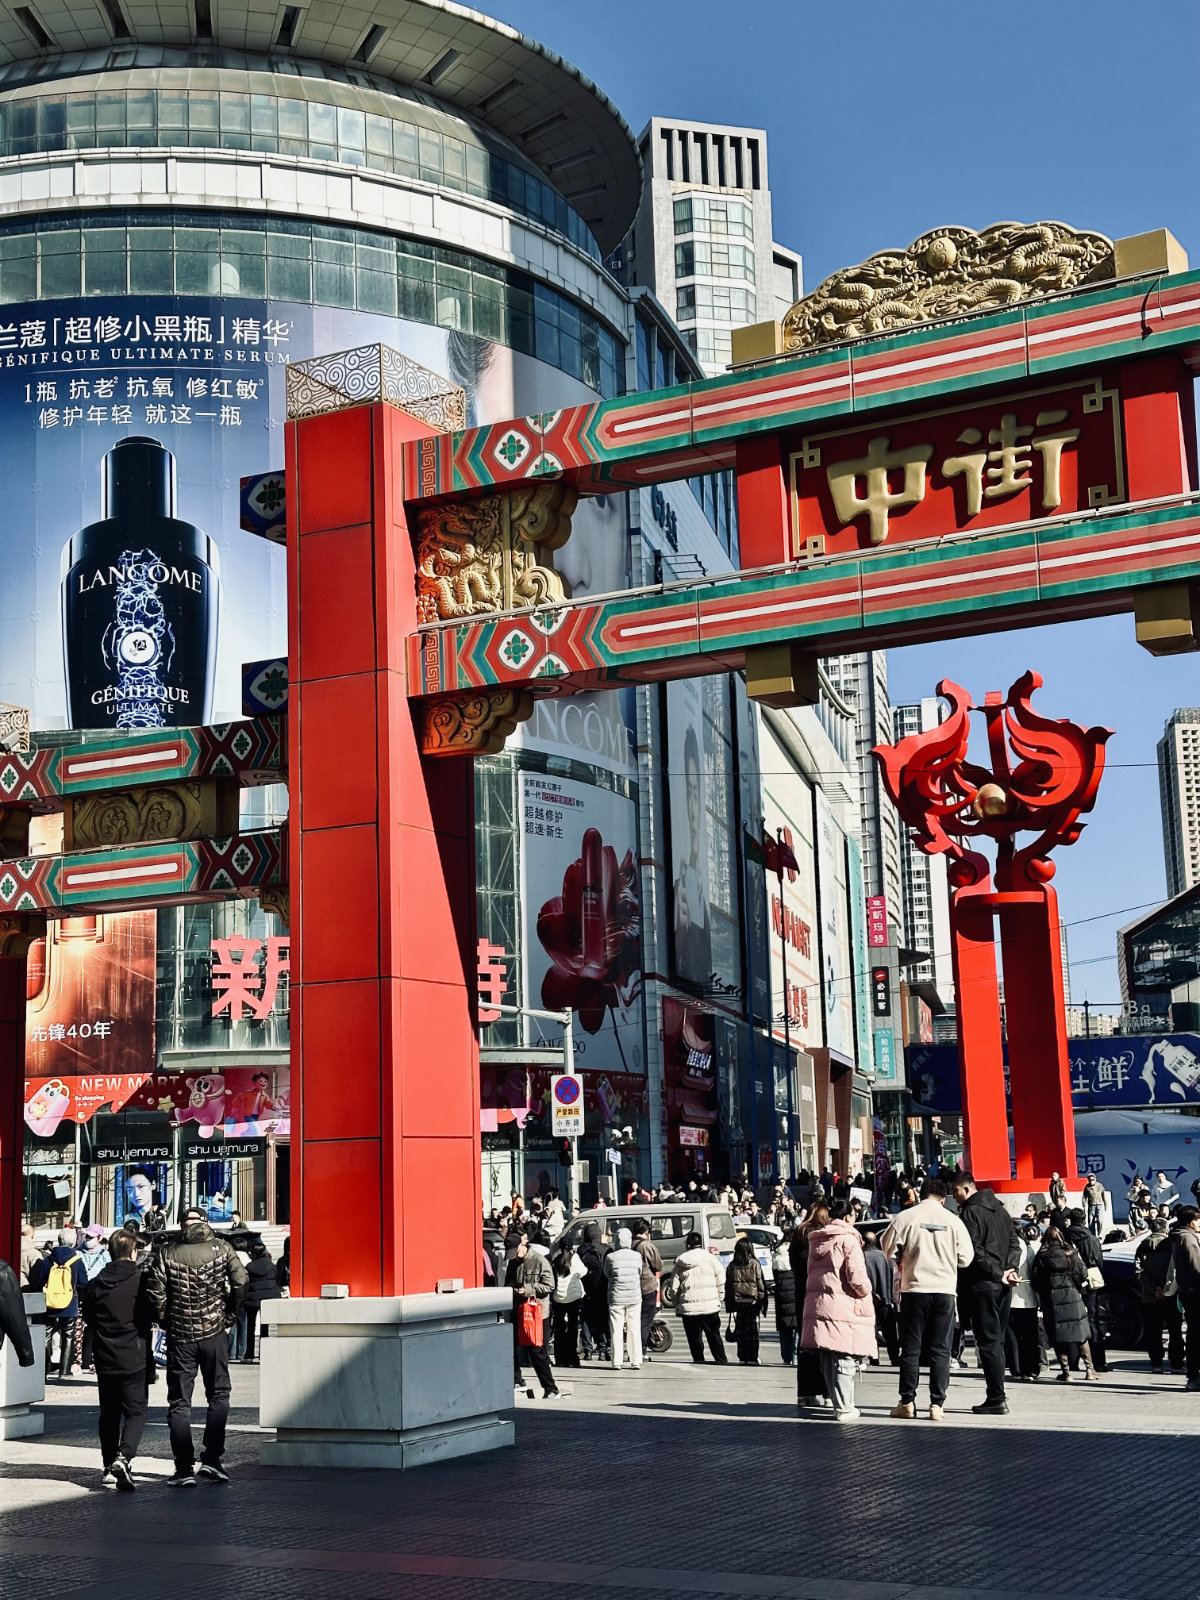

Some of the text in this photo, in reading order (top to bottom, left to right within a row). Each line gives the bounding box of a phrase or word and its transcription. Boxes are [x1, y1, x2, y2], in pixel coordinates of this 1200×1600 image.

[111, 347, 214, 360] ULTIMATE
[224, 349, 291, 364] SERUM
[24, 381, 58, 403] 1瓶
[126, 376, 174, 398] 抗氧
[39, 403, 242, 429] 修护年轻 就这一瓶
[826, 408, 1081, 544] 中街
[78, 562, 202, 594] LANCÔME
[91, 684, 190, 705] GÉNIFIQUE
[106, 702, 175, 715] ULTIMATE
[524, 805, 563, 823] 超越修护
[872, 910, 884, 944] 新玛特
[876, 982, 887, 1011] 必胜客
[81, 1076, 180, 1092] NEW MART
[1097, 1056, 1130, 1089] 鲜
[97, 1146, 169, 1159] shu uemura
[188, 1142, 259, 1155] shu uemura
